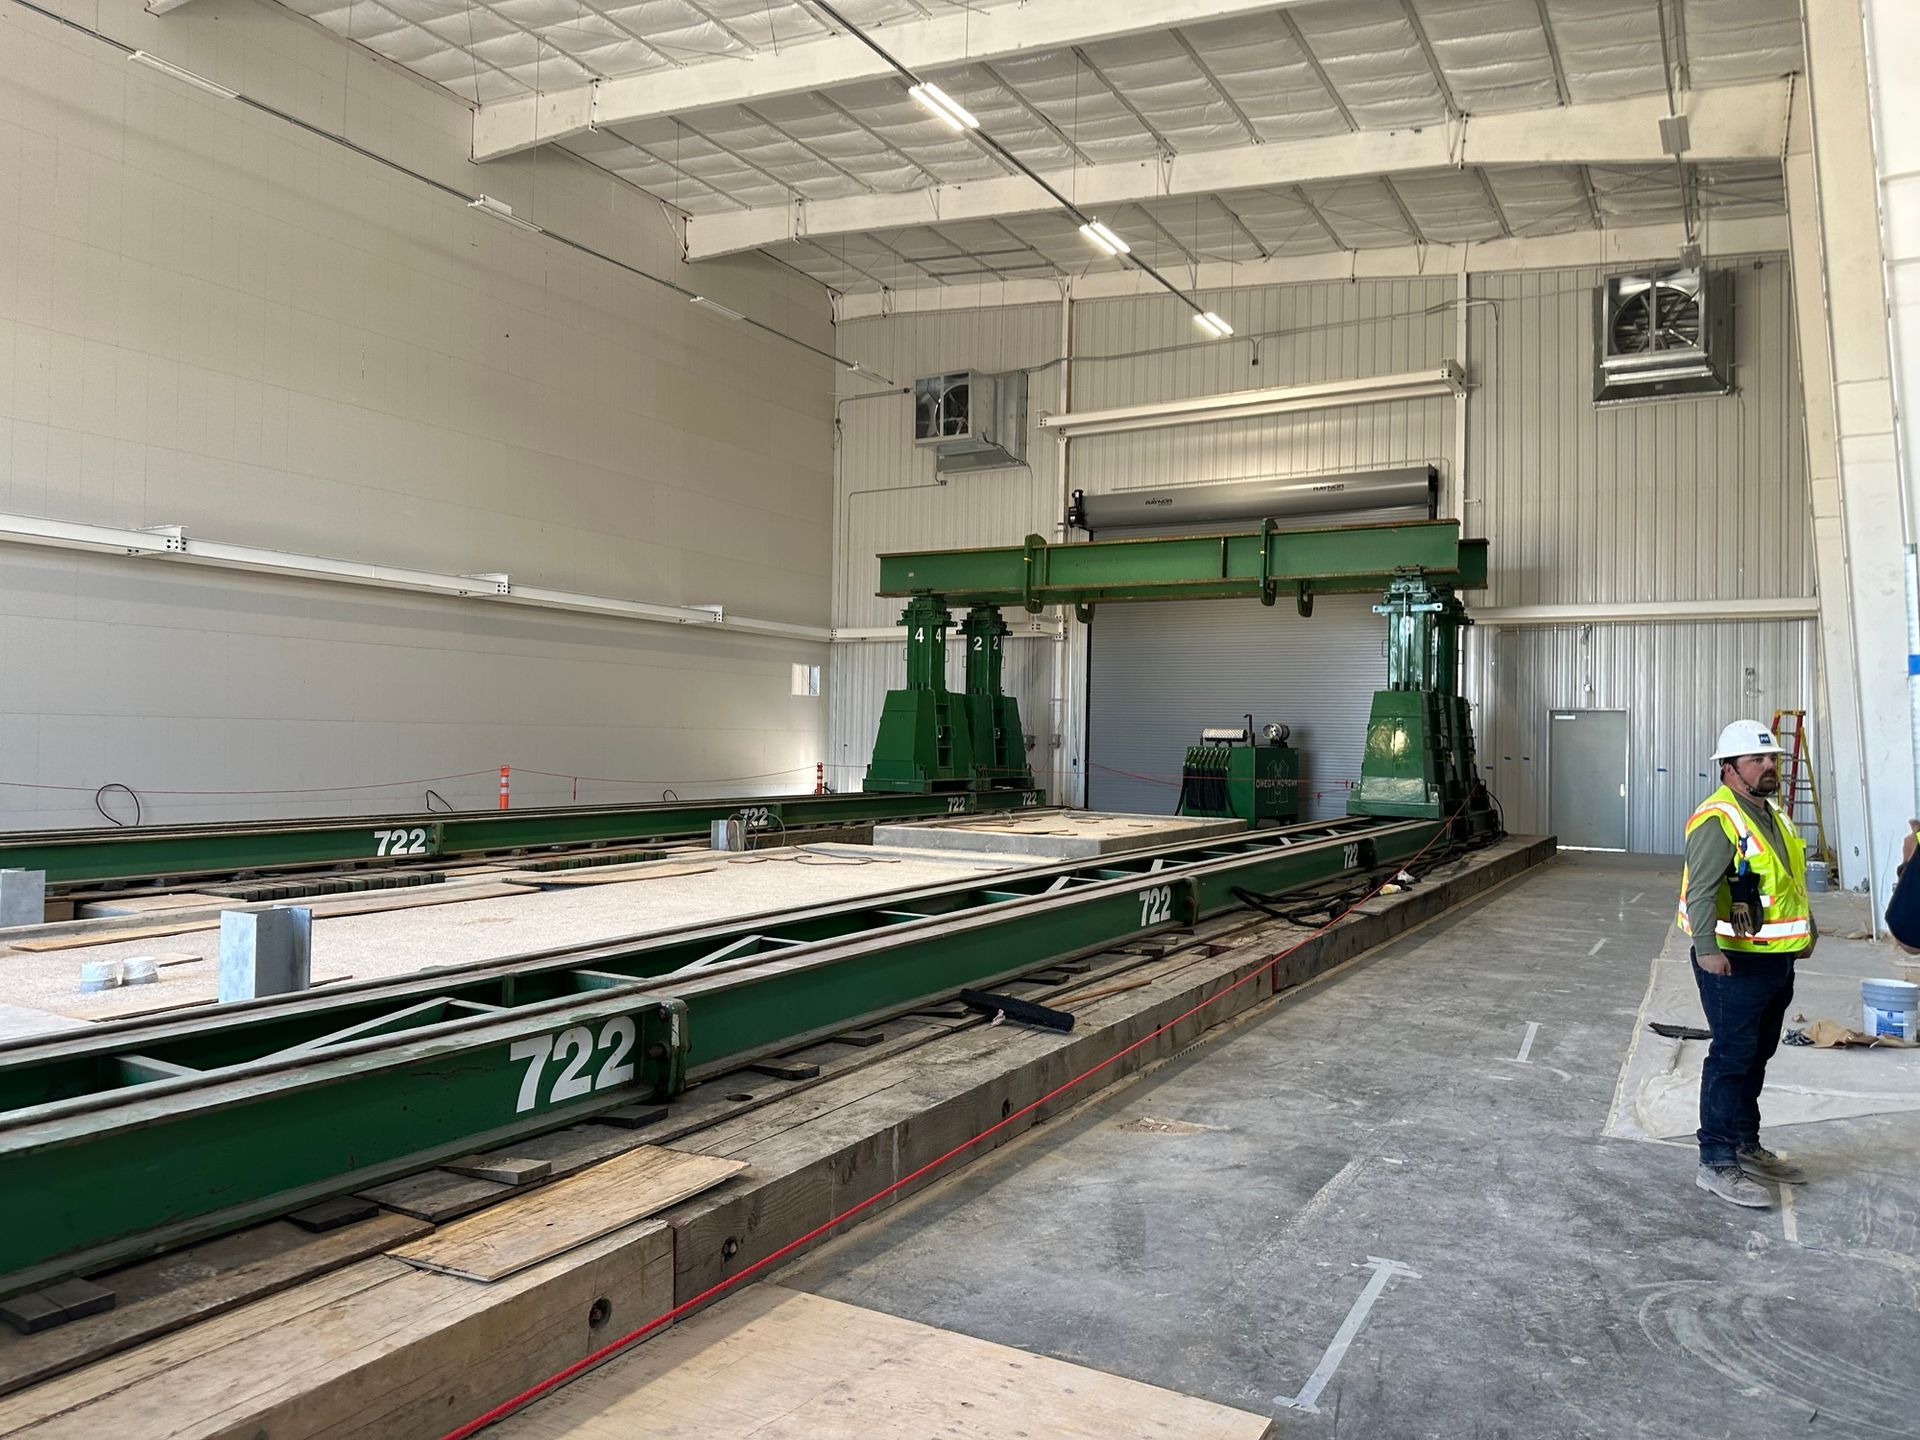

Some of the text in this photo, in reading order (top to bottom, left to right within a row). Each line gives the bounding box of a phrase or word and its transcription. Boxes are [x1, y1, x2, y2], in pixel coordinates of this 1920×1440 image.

[915, 627, 924, 643] 4
[935, 627, 942, 643] 4
[993, 635, 999, 650] 2
[974, 636, 983, 651] 2
[947, 796, 966, 812] 722
[1022, 791, 1037, 806] 722
[740, 806, 768, 827] 722
[374, 827, 426, 857] 722
[1343, 842, 1358, 869] 722
[1139, 885, 1171, 927] 722
[510, 1015, 636, 1113] 722
